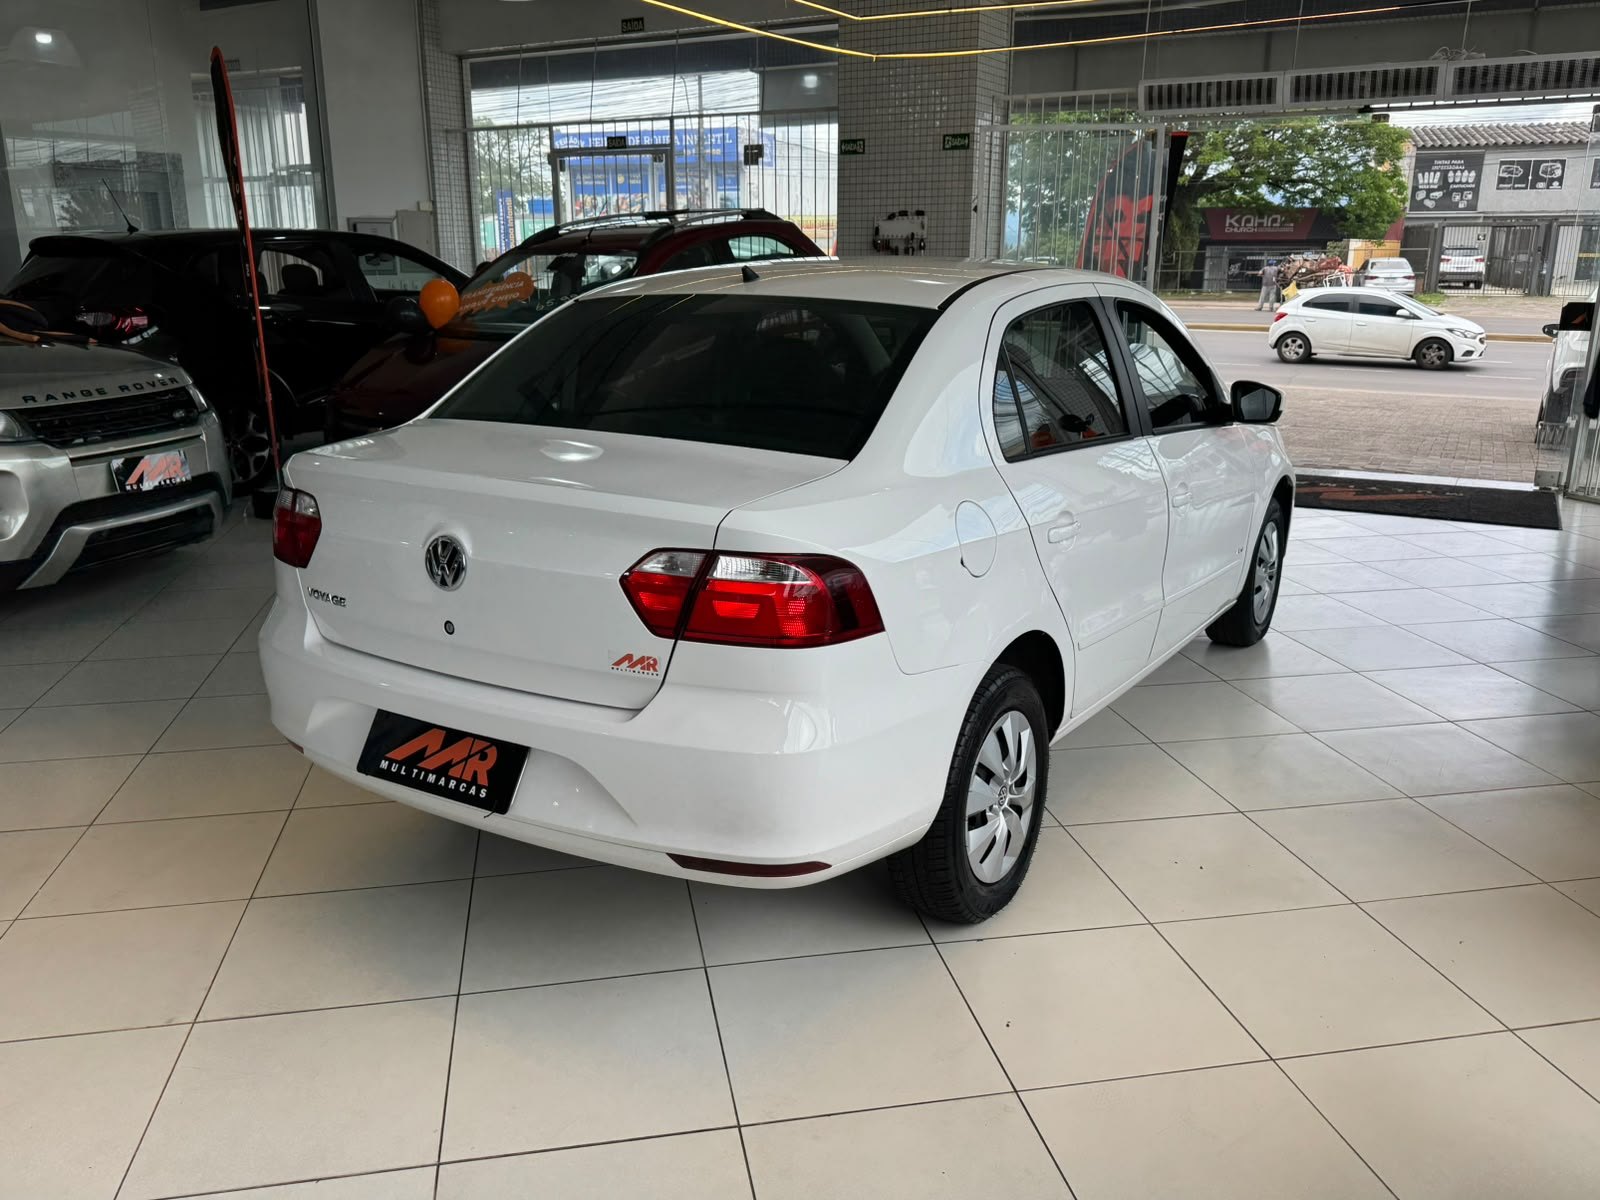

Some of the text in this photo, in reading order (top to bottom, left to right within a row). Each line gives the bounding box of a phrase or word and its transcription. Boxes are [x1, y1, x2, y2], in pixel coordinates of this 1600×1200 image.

[22, 377, 180, 404] RANGE ROVER
[307, 586, 347, 607] VOYAGE
[379, 759, 488, 798] MULTIMARCAS
